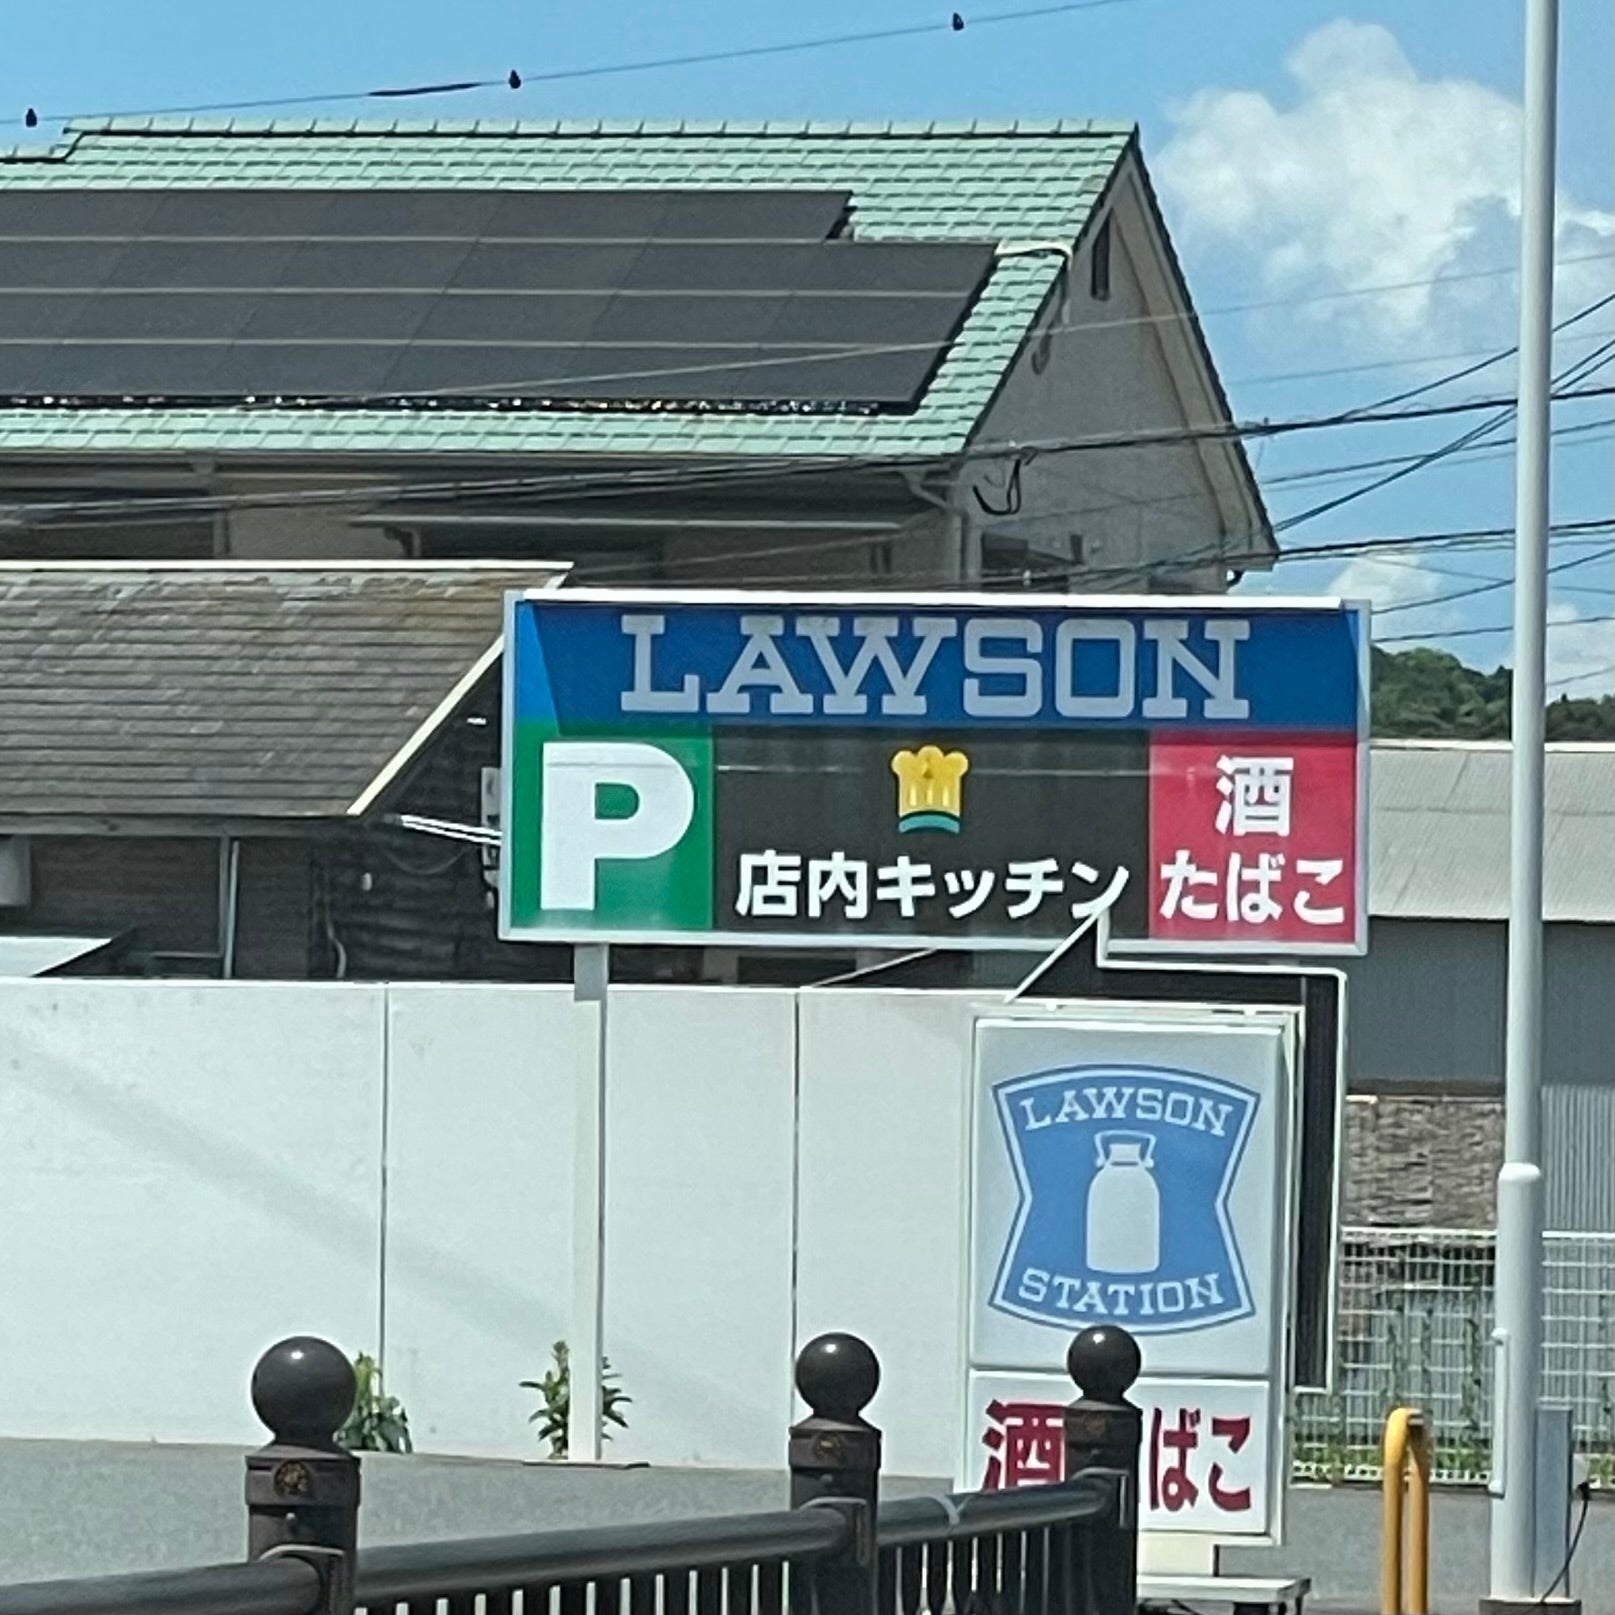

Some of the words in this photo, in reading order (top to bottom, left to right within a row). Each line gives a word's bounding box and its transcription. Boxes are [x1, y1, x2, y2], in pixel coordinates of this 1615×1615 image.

[621, 615, 1251, 720] LAWSON
[540, 742, 695, 910] P
[1215, 755, 1294, 836] 酒
[735, 849, 1130, 920] 店内キッチン
[1160, 849, 1345, 925] たばこ
[1020, 1086, 1233, 1137] LAWSON
[1018, 1267, 1225, 1315] STATION
[1149, 1407, 1251, 1512] ばこ
